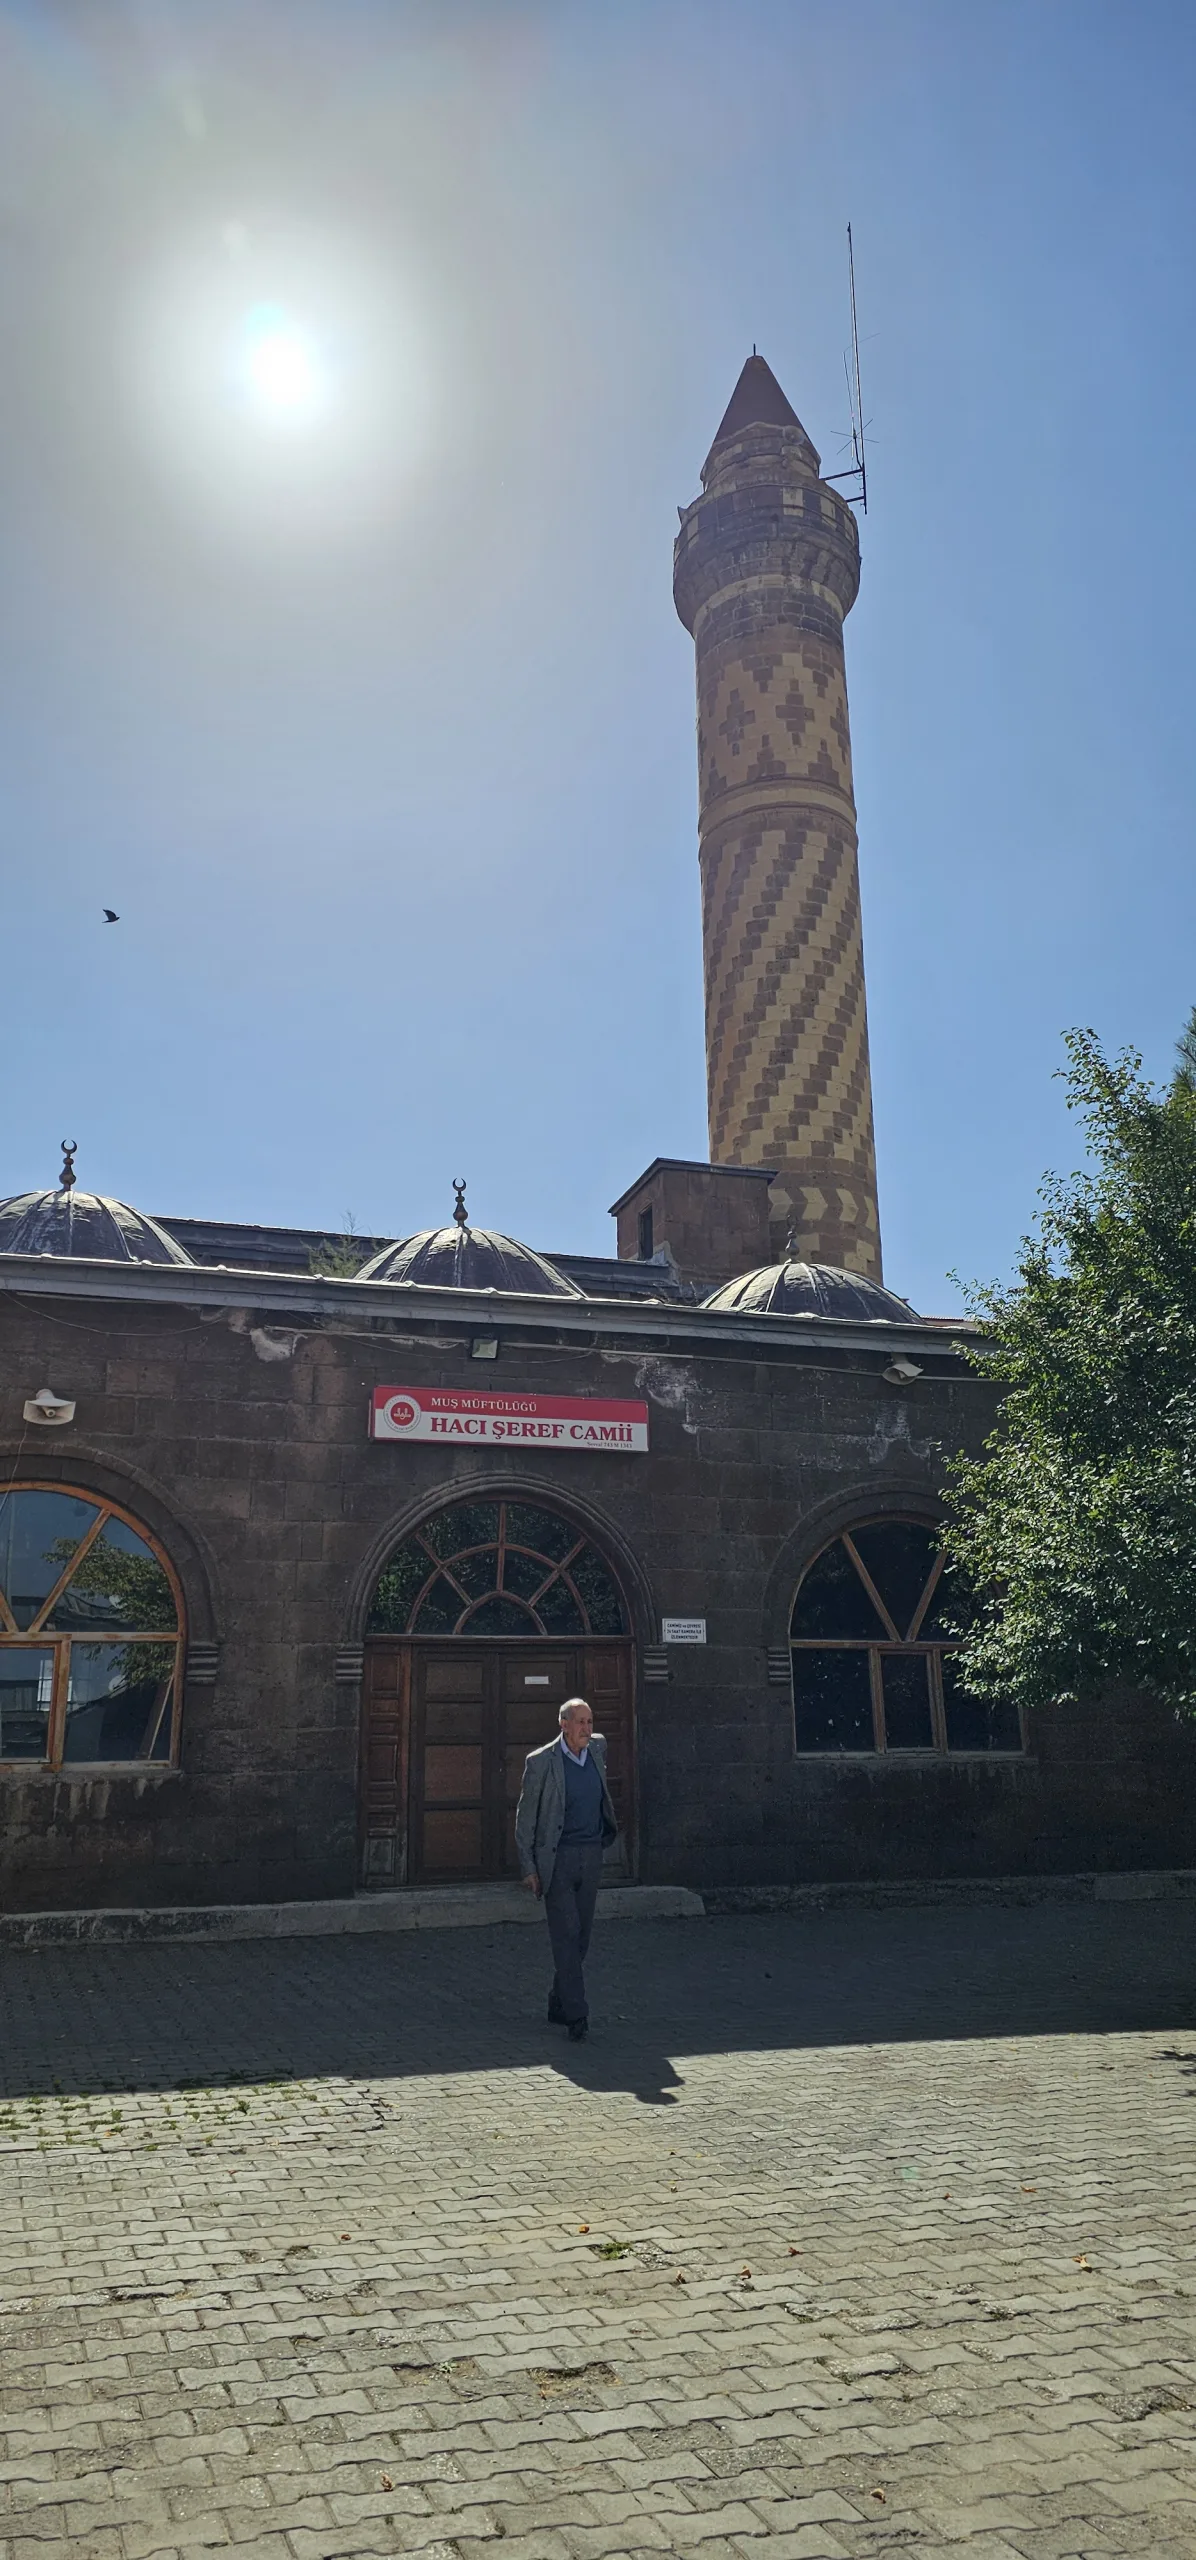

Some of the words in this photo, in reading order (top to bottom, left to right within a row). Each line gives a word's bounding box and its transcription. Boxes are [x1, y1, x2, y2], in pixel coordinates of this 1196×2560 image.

[431, 1397, 458, 1409] MUŞ
[461, 1398, 537, 1412] MÜFTÜLÜĞÜ
[430, 1417, 487, 1435] HACI
[492, 1420, 565, 1439] ŞEREF
[569, 1423, 633, 1442] CAMİİ
